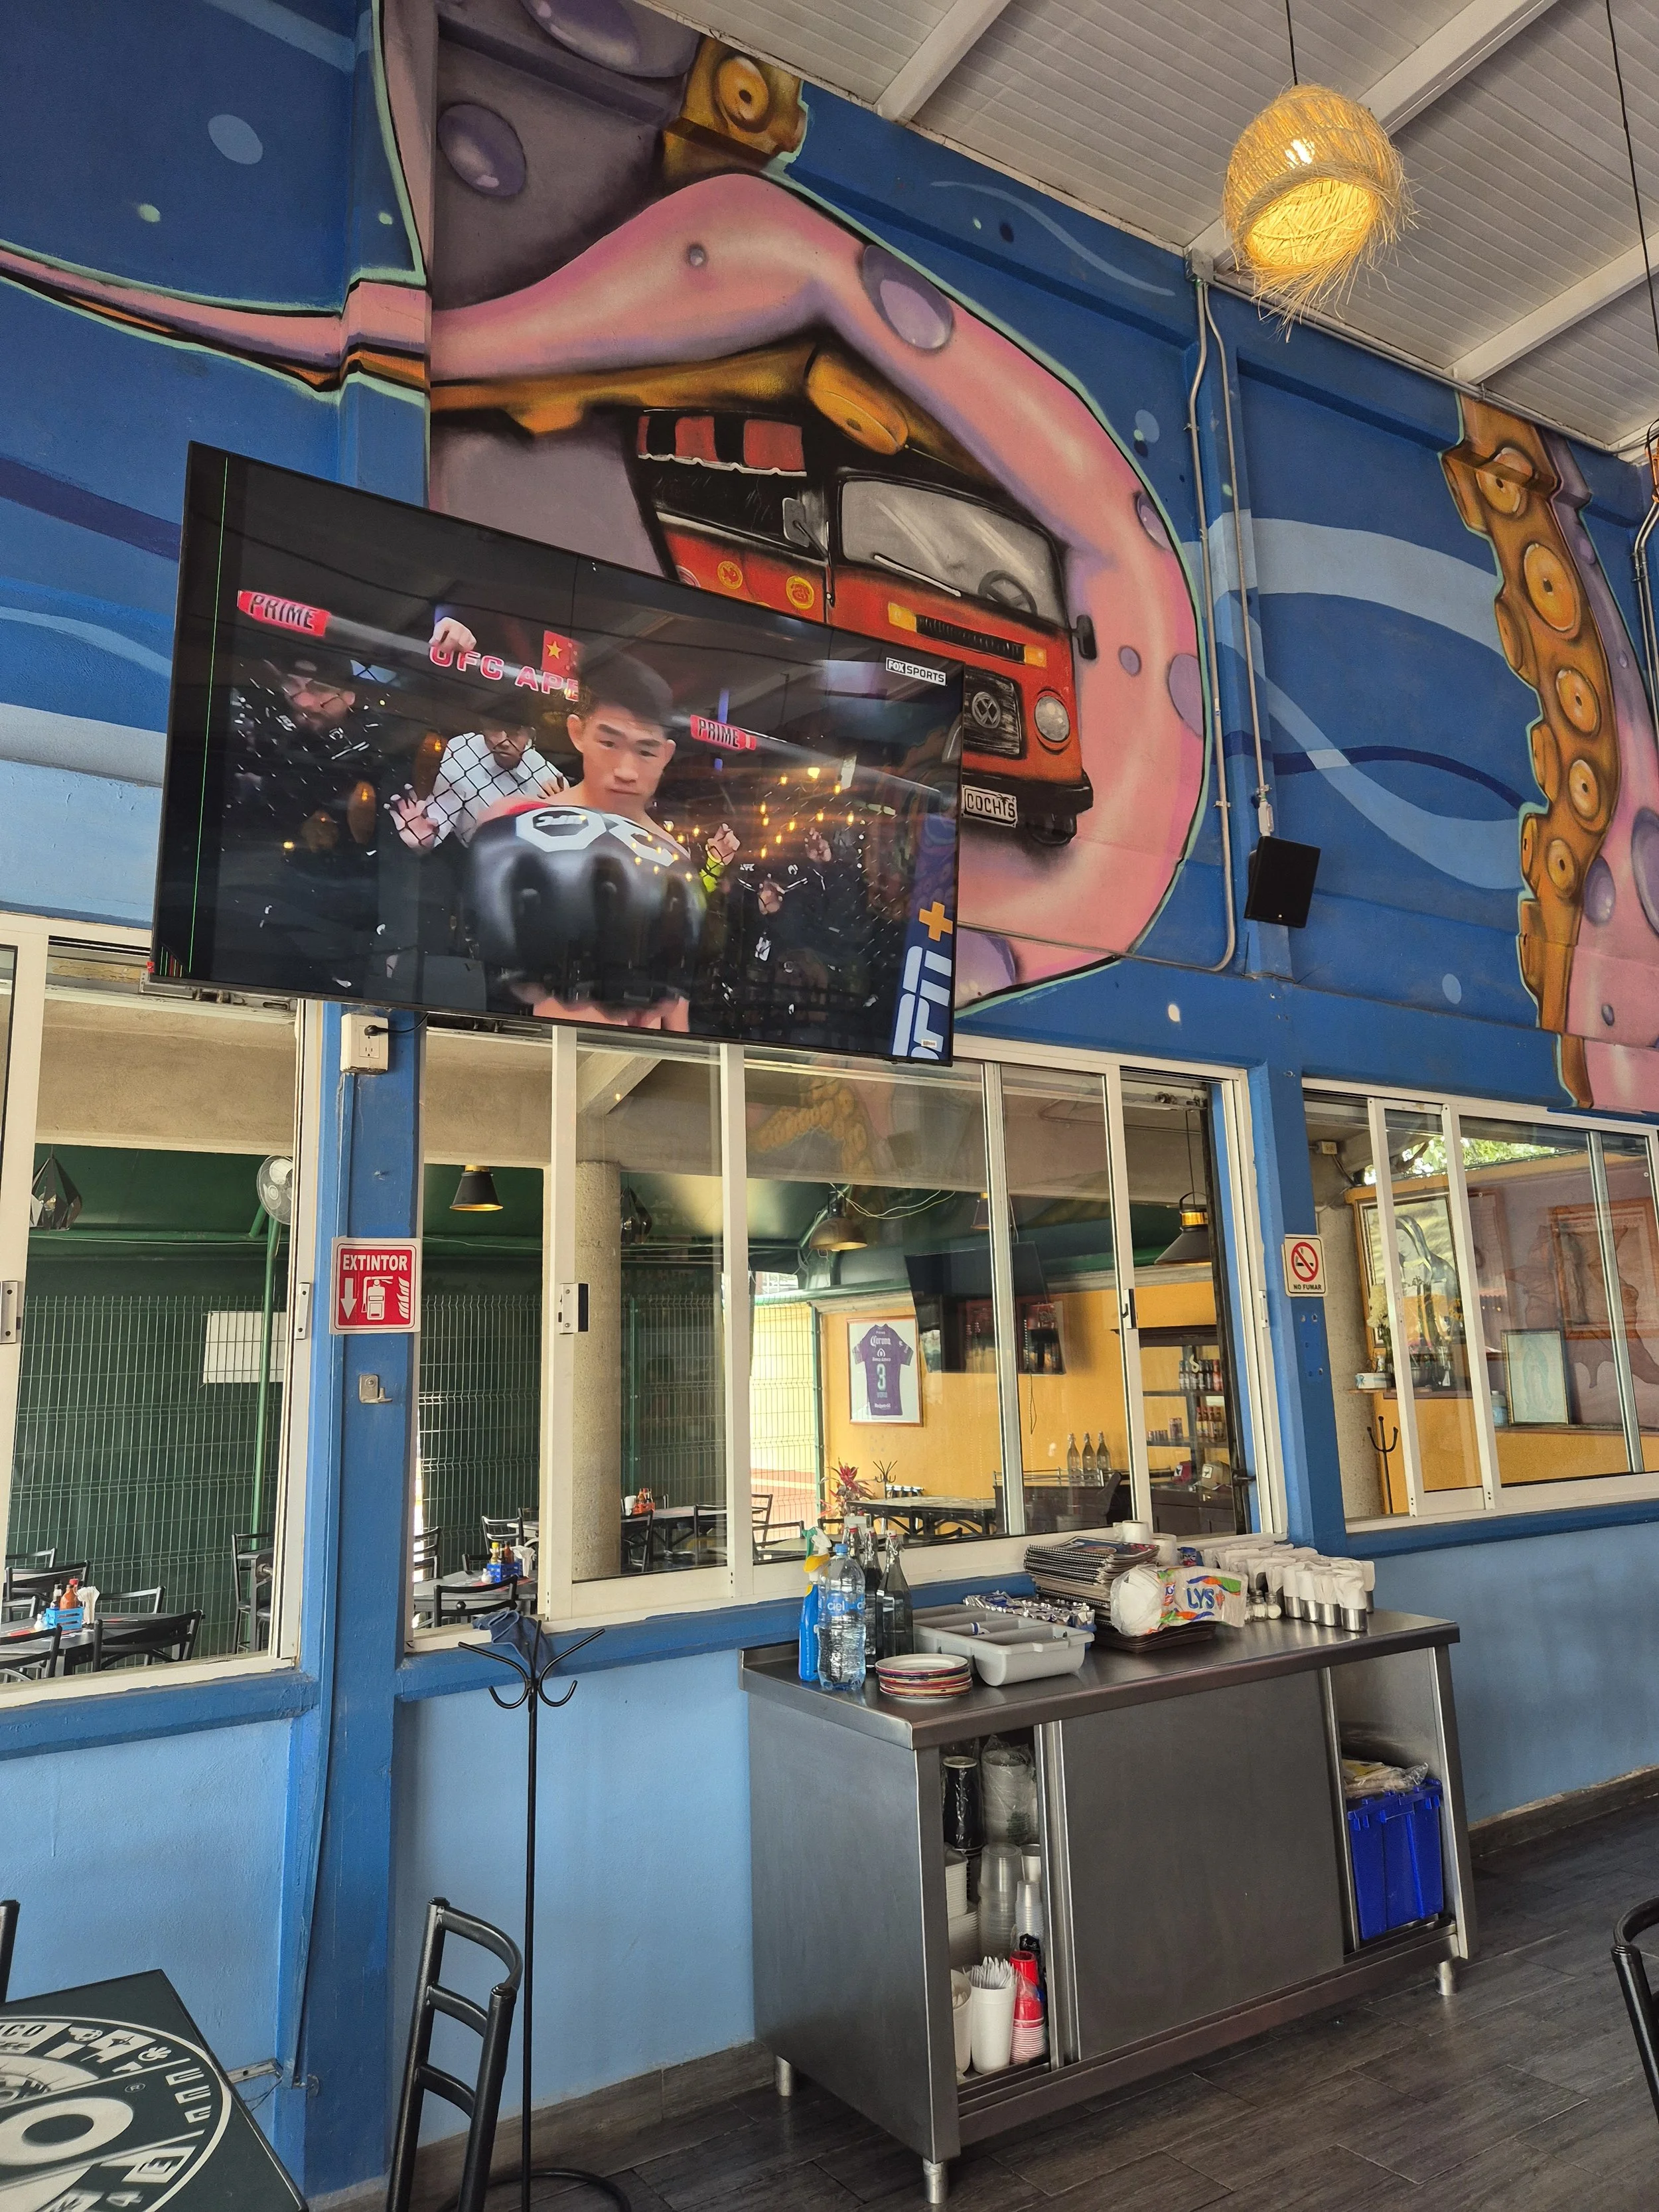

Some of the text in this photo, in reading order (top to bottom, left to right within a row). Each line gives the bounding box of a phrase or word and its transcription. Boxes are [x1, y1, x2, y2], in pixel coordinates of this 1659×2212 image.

[248, 593, 317, 631] PRIME
[429, 646, 579, 702] UFC APE
[887, 660, 945, 683] FOX SPORTS
[697, 715, 740, 749] PRIME
[342, 1254, 408, 1272] EXTINTOR
[870, 1335, 892, 1348] Corona
[1187, 1587, 1215, 1610] LYS
